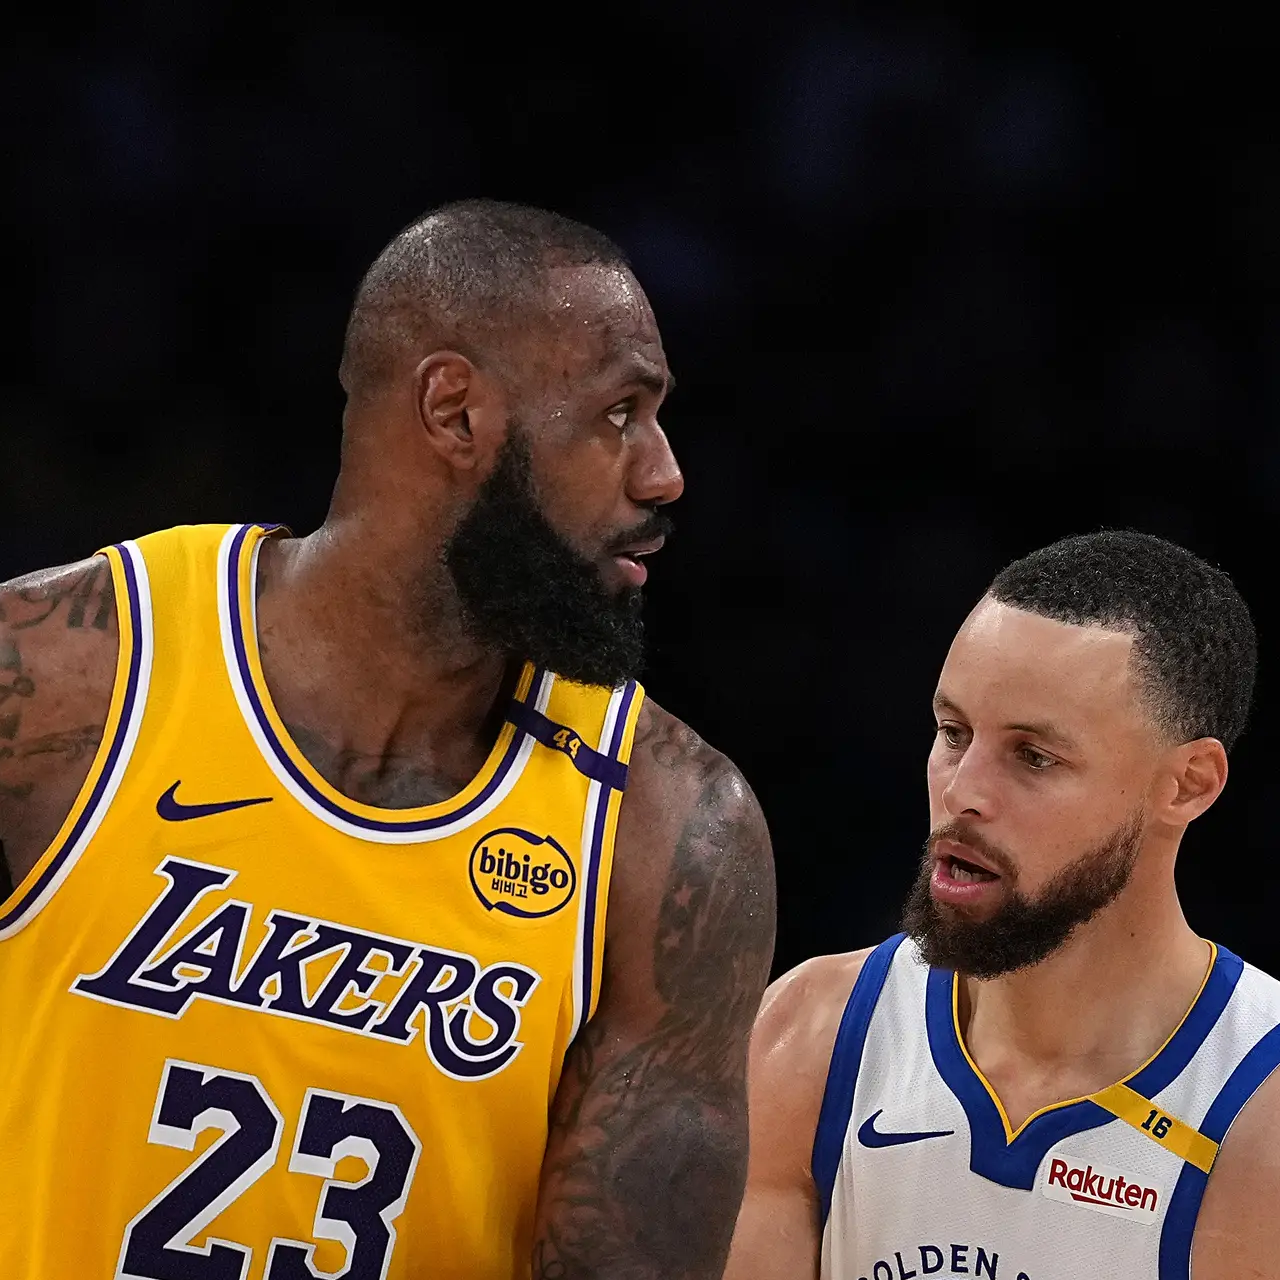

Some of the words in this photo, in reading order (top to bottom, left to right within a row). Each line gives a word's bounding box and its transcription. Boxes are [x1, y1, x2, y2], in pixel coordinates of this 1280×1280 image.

[552, 727, 582, 759] 44
[479, 846, 569, 895] bibigo
[491, 877, 528, 898] 비비고
[69, 854, 542, 1081] LAKERS
[1141, 1109, 1173, 1139] 16
[1047, 1158, 1158, 1212] Rakuten
